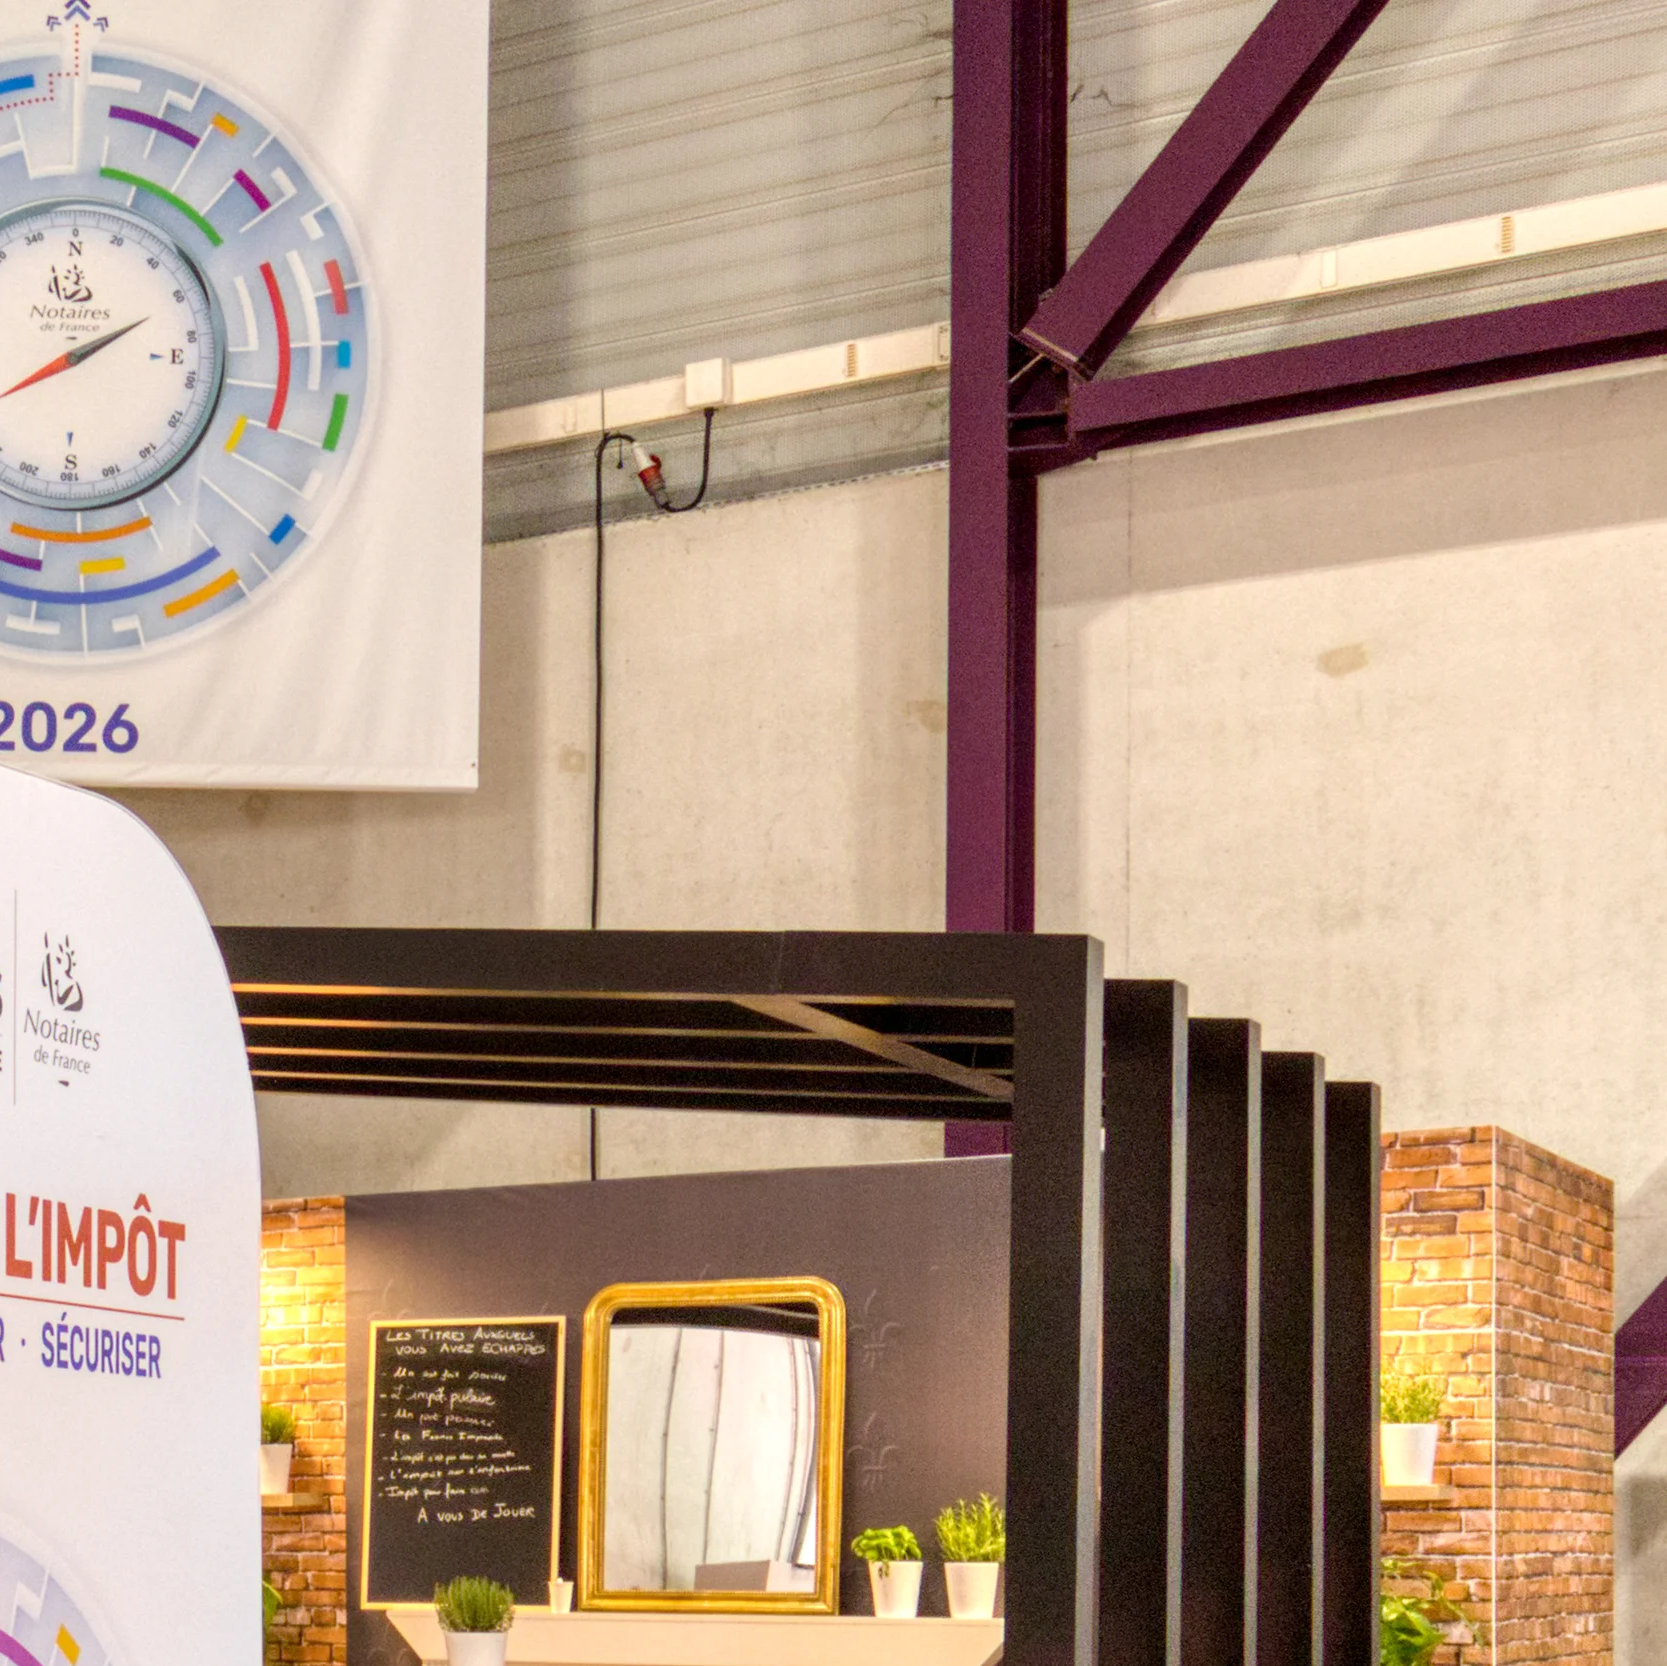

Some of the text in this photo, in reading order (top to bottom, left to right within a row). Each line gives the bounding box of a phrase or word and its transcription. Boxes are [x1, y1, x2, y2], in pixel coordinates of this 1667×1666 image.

[24, 232, 45, 246] 340
[72, 228, 79, 238] 0
[68, 241, 83, 256] N
[110, 235, 124, 247] 20
[146, 256, 159, 270] 40
[172, 289, 184, 304] 60
[30, 304, 110, 320] Notaires
[40, 322, 100, 332] de France
[186, 330, 196, 344] 80
[171, 349, 184, 365] E
[184, 370, 196, 390] 100
[168, 410, 183, 429] 120
[139, 442, 157, 459] 140
[19, 461, 39, 477] 200
[65, 455, 77, 470] S
[60, 472, 79, 482] 180
[102, 463, 122, 478] 160
[24, 1008, 101, 1052] Notaires
[34, 1044, 91, 1075] de France
[5, 1192, 186, 1300] L'IMPÔT
[40, 1312, 161, 1379] SÉCURISER
